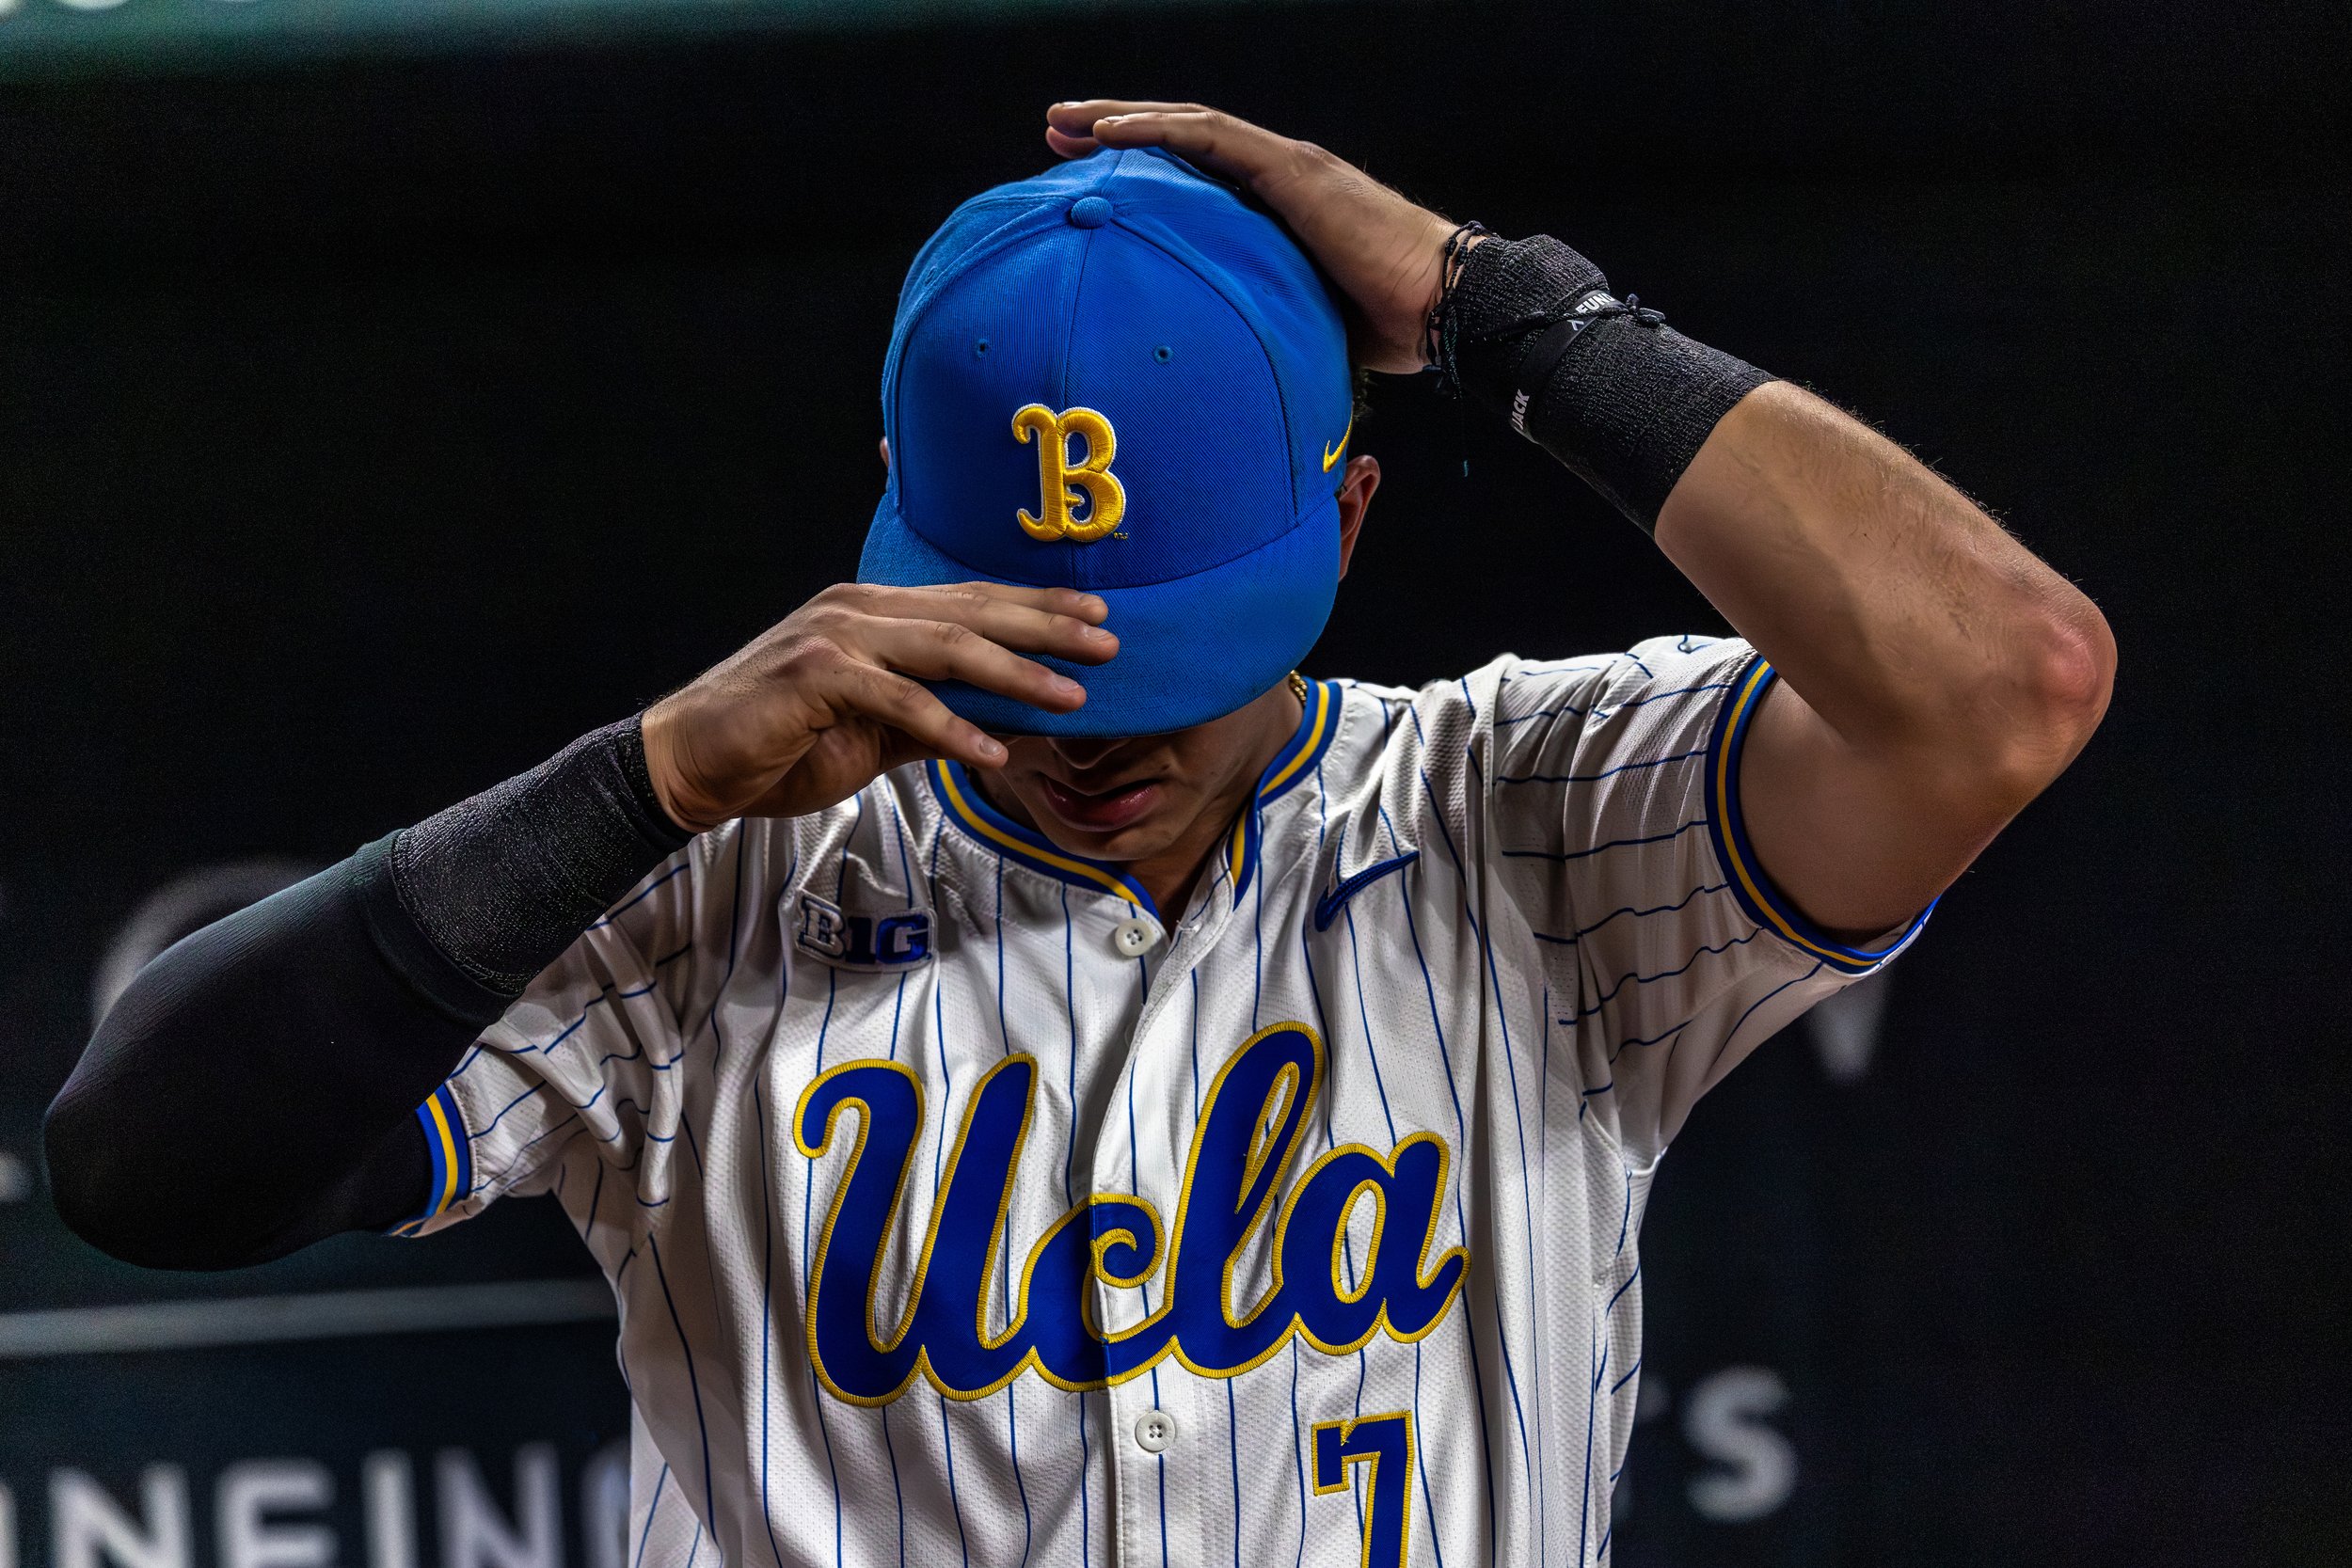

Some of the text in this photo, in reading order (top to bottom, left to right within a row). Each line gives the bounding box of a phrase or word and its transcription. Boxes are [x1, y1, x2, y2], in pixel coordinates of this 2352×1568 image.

[1011, 402, 1126, 543] B
[1511, 388, 1530, 431] JACK
[1311, 1410, 1413, 1568] 7
